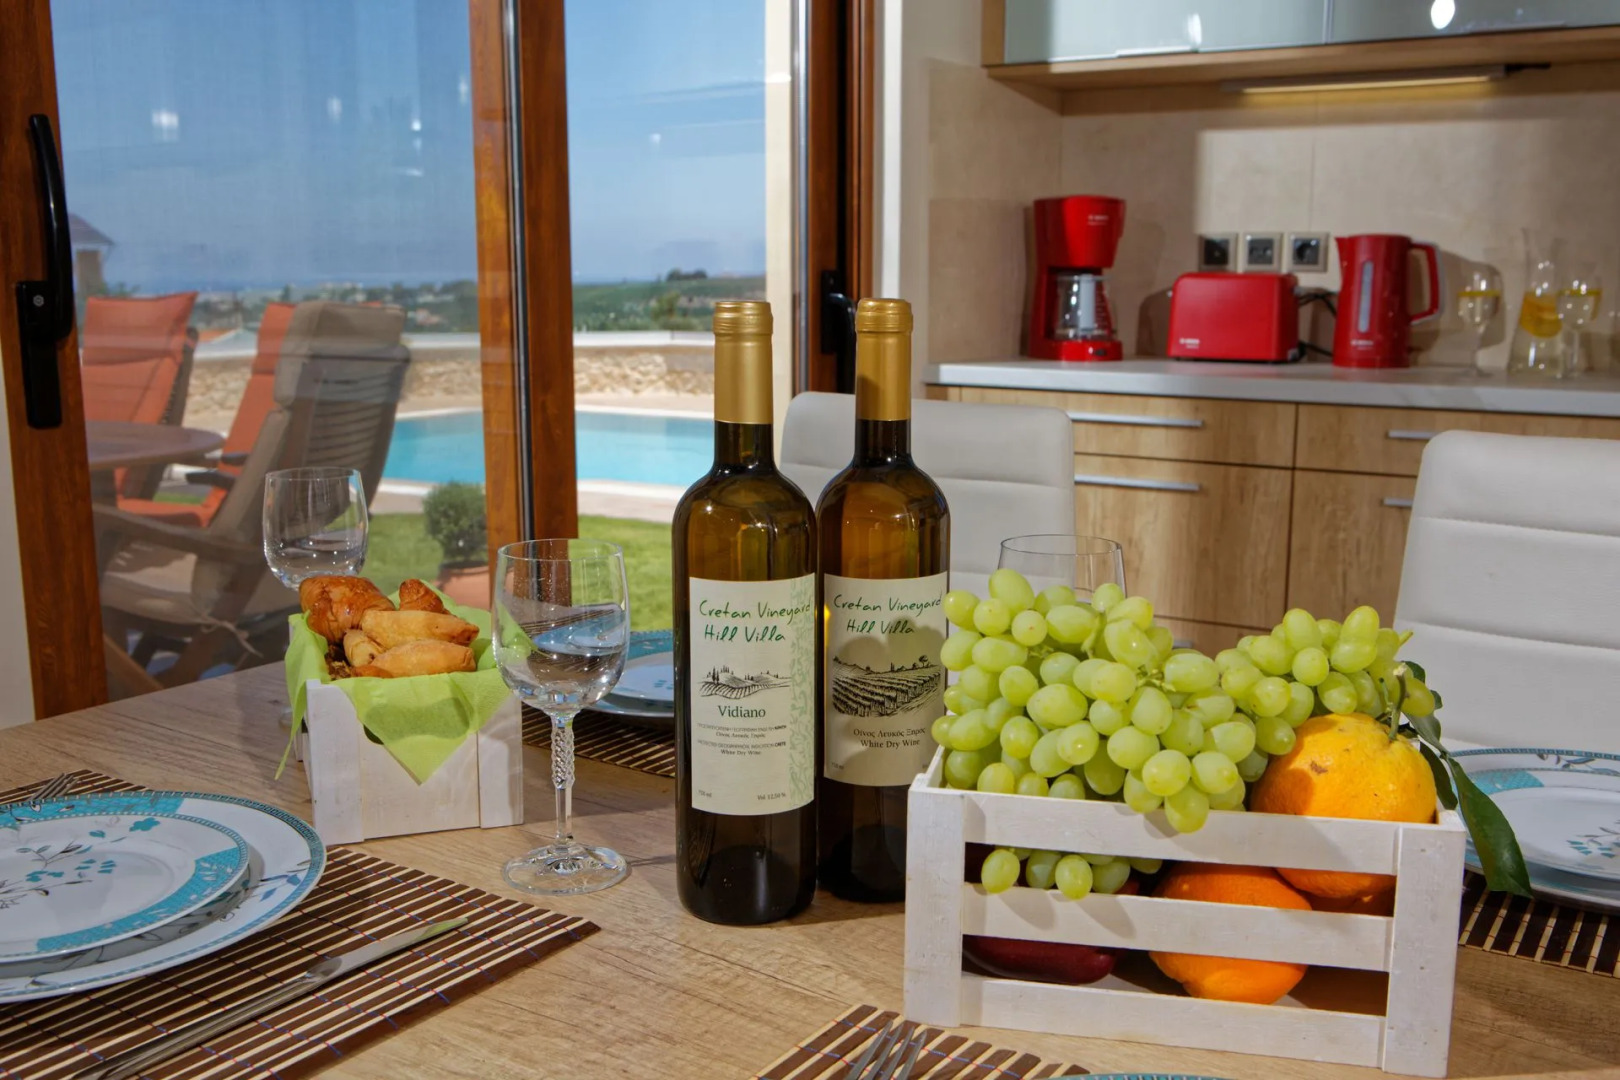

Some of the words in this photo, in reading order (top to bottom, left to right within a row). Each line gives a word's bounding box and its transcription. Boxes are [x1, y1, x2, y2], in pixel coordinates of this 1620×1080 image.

[700, 600, 751, 618] Cretan
[758, 597, 811, 625] Vineyard
[833, 594, 881, 611] Cretan
[889, 590, 942, 617] Vineyard
[705, 624, 738, 641] Hill
[745, 625, 785, 642] Villa
[846, 619, 876, 634] Hill
[880, 619, 915, 634] Villa
[718, 705, 766, 718] Vidiano
[860, 739, 884, 749] White
[886, 740, 900, 750] Dry
[902, 739, 920, 747] Wine
